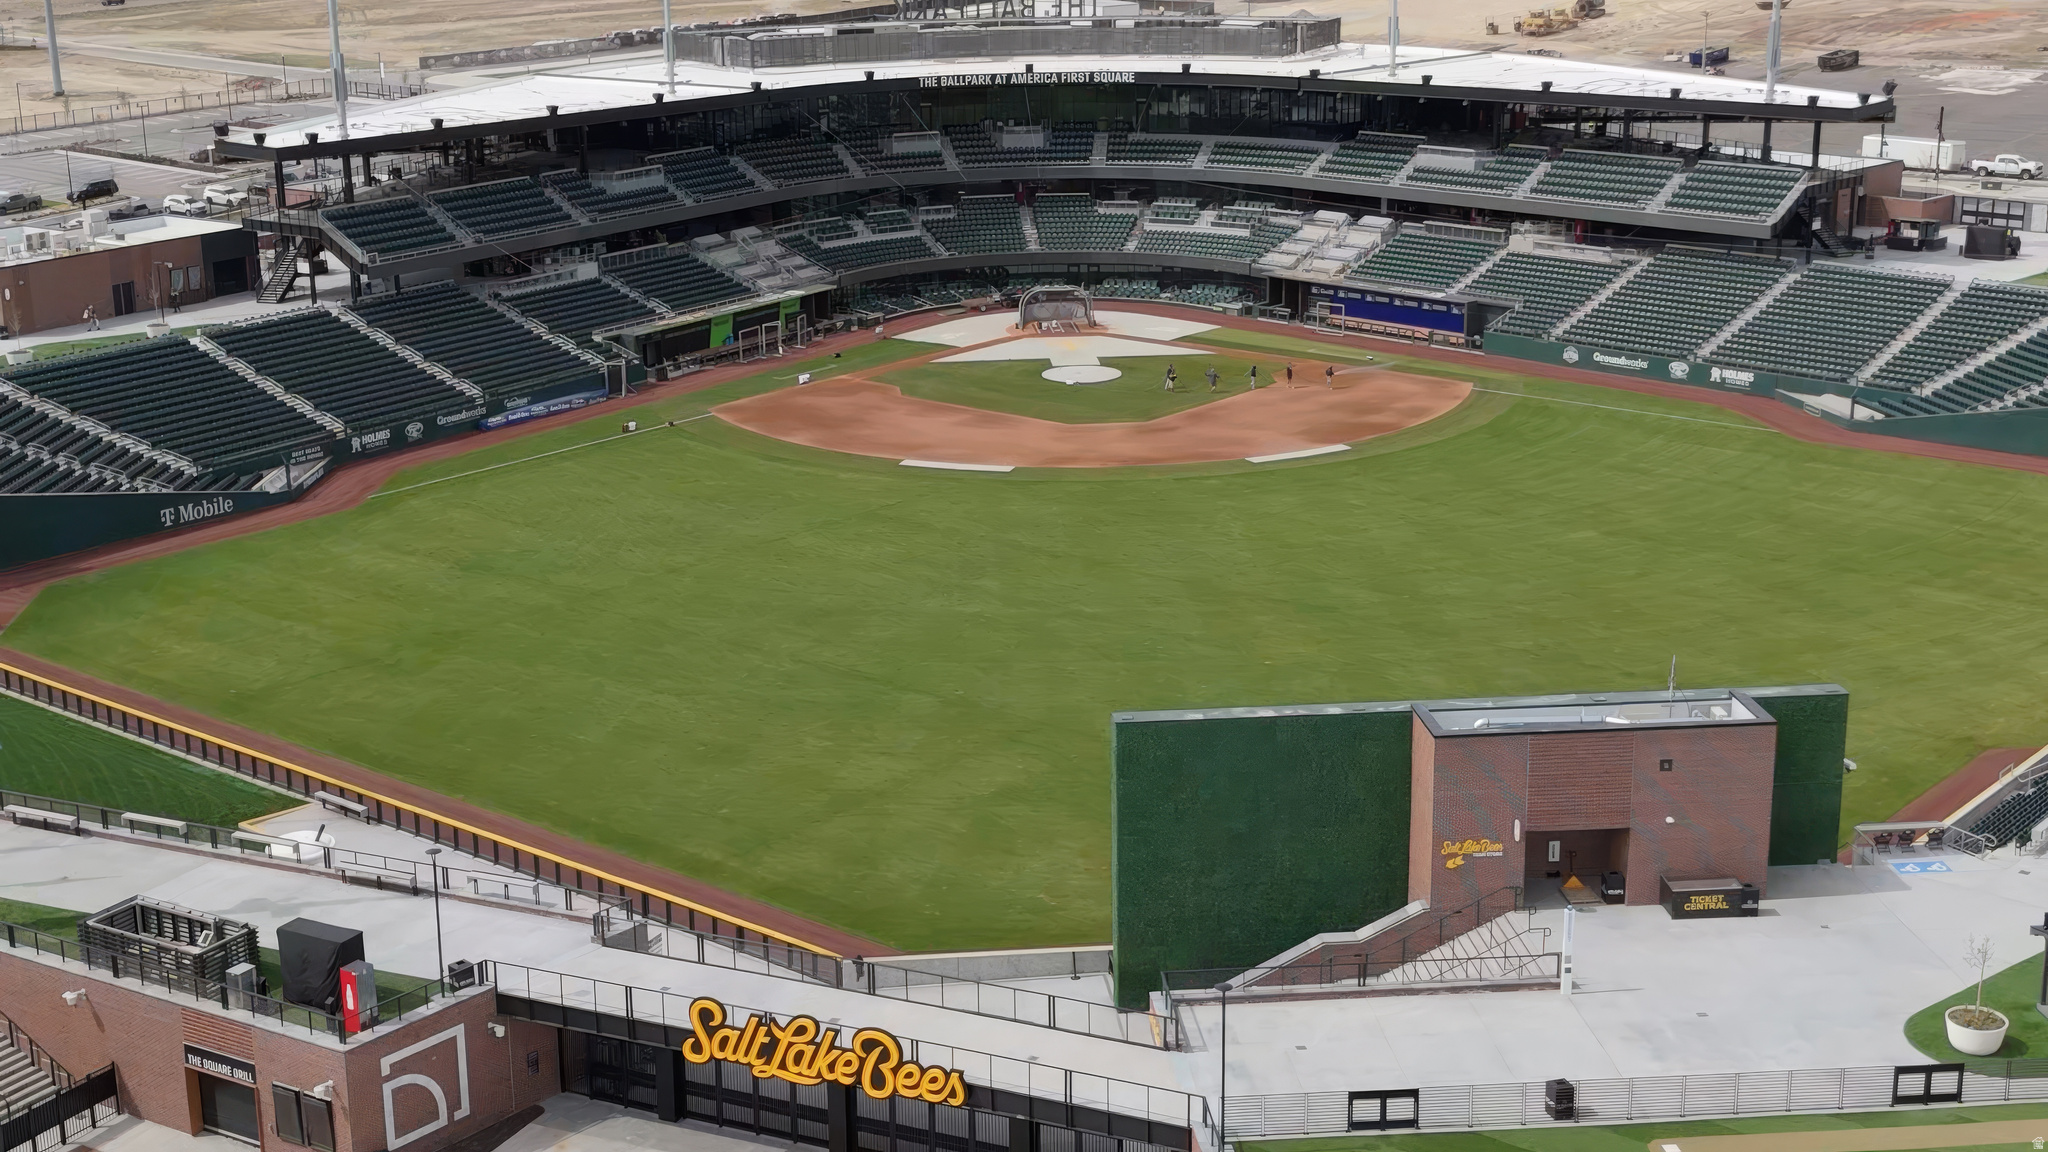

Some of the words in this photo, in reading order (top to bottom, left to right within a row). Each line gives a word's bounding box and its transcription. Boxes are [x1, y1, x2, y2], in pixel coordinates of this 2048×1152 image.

[919, 76, 938, 88] THE
[940, 75, 992, 87] BALLPARK
[995, 74, 1007, 85] AT
[1010, 73, 1058, 84] AMERICA
[1061, 72, 1090, 83] FIRST
[1093, 72, 1135, 83] SQUARE
[1722, 368, 1754, 382] HOLMES
[361, 428, 391, 445] HOLMES
[178, 496, 234, 524] Mobile
[1684, 901, 1729, 911] CENTRAL
[1689, 894, 1725, 904] TICKET
[681, 998, 771, 1066] Salt
[752, 1016, 860, 1086] Lake
[852, 1029, 967, 1107] Bees
[187, 1053, 202, 1068] THE
[202, 1058, 232, 1077] SQUARE
[233, 1067, 254, 1083] GRILL
